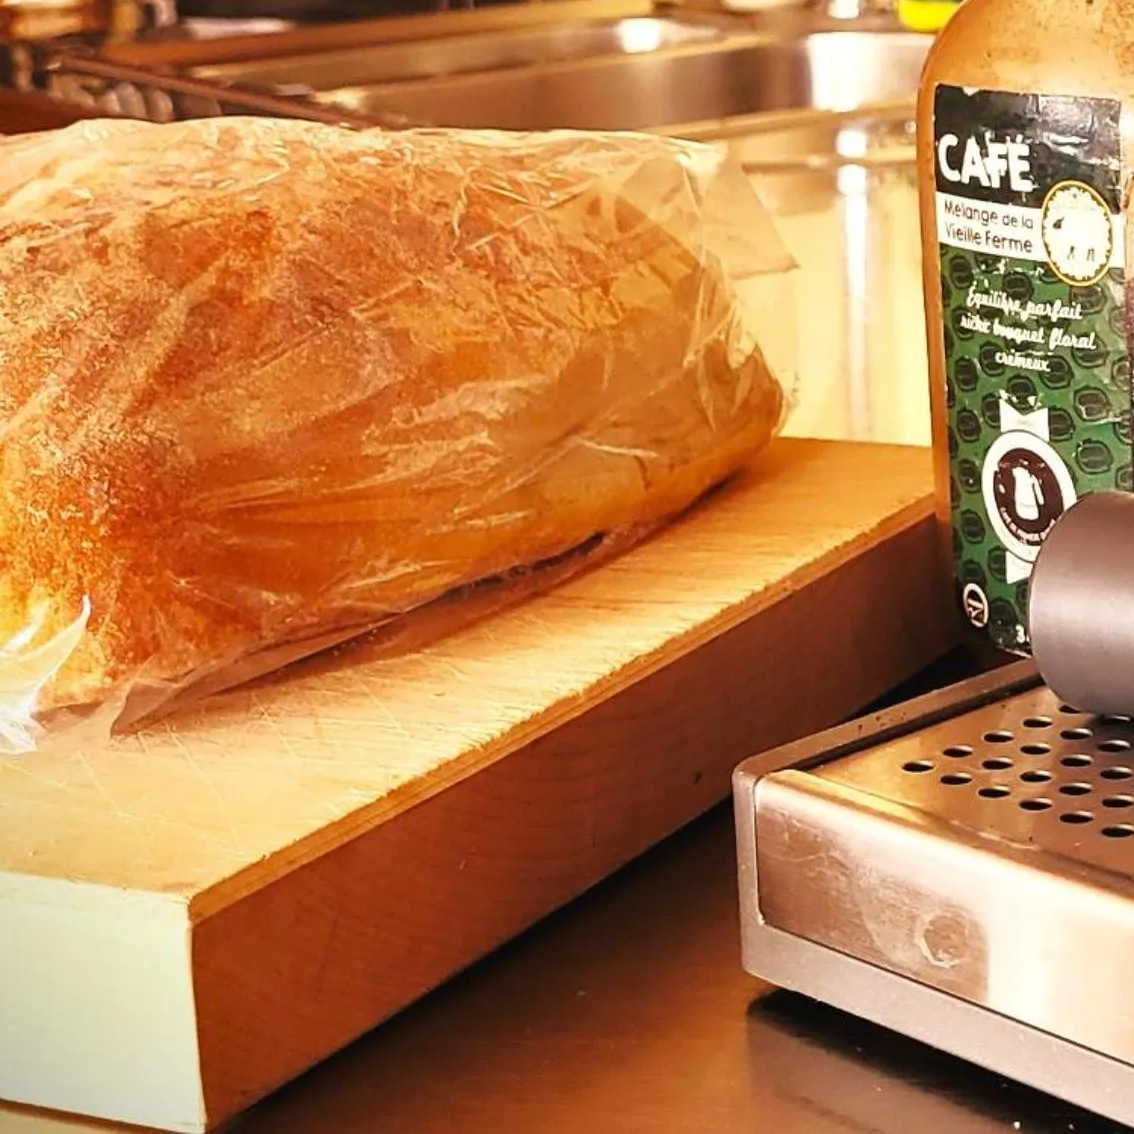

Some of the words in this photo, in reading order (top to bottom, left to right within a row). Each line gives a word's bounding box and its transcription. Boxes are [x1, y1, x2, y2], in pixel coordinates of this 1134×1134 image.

[1002, 214, 1018, 227] de
[1022, 215, 1034, 229] la
[946, 221, 982, 245] Vieille
[985, 230, 1033, 253] Ferme
[1049, 328, 1097, 350] floral
